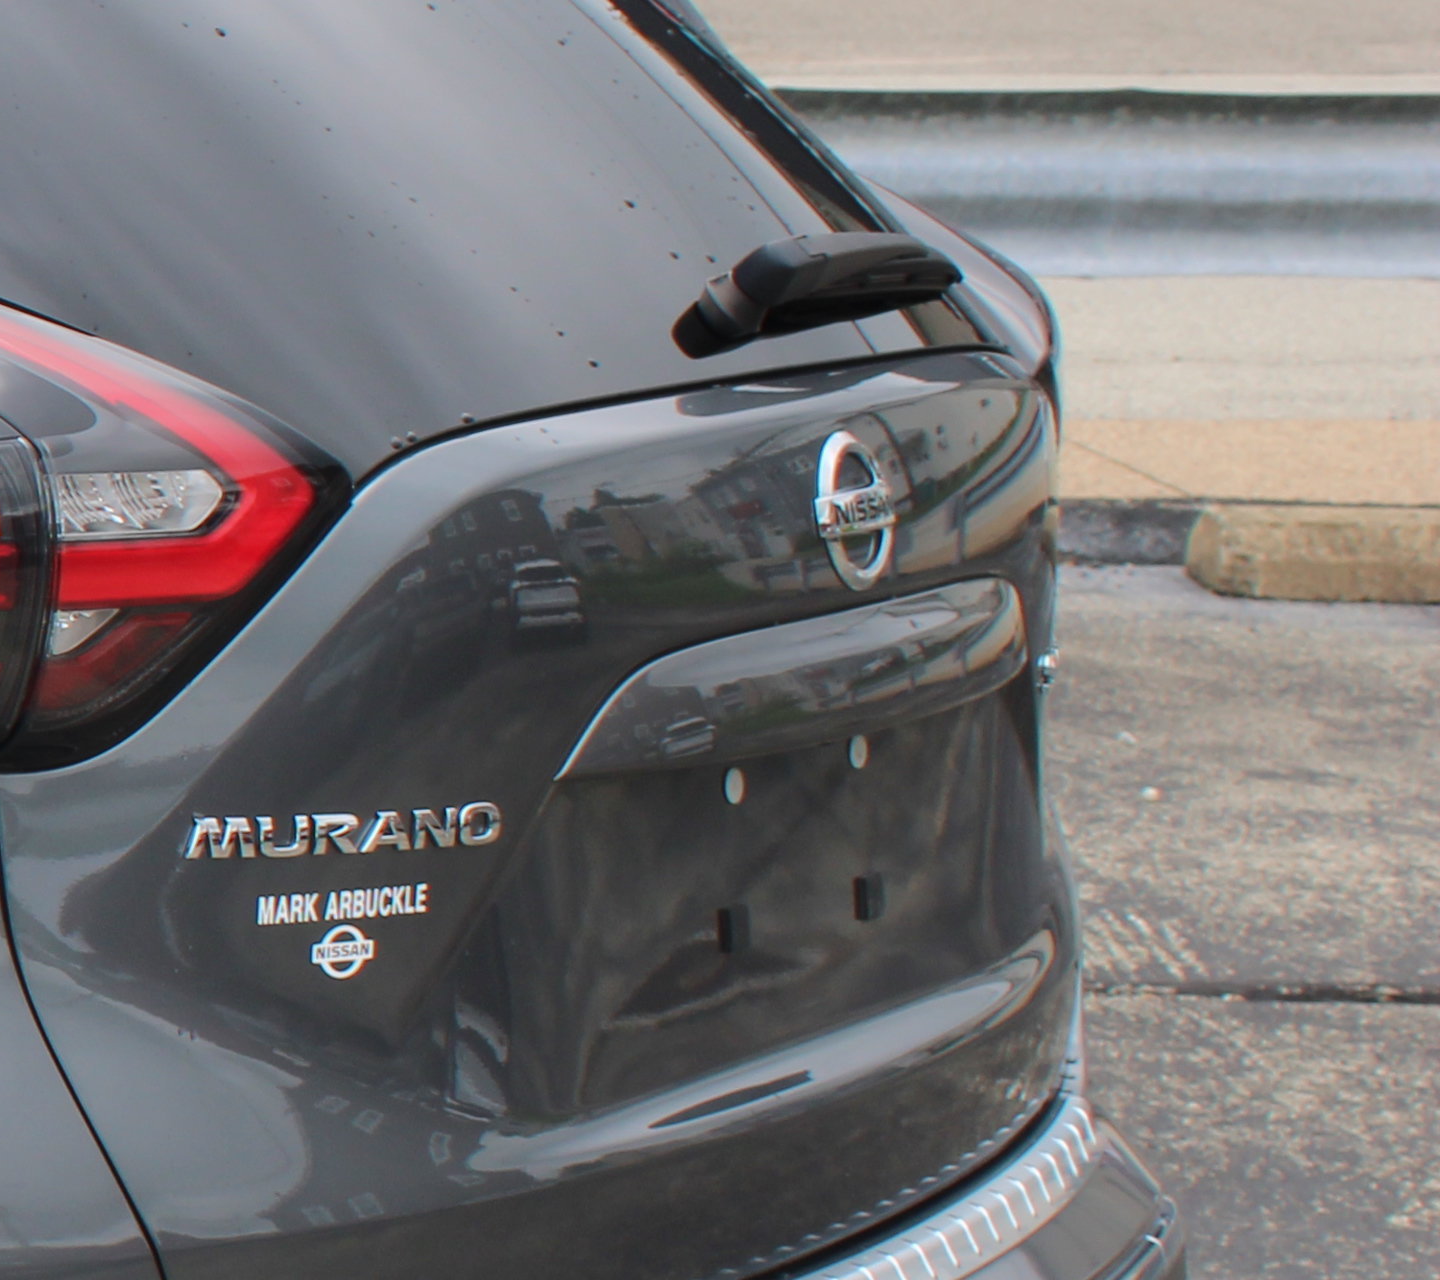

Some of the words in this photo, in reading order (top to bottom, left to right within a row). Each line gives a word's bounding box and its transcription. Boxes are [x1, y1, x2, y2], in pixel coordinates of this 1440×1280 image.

[184, 801, 503, 860] MURANO
[257, 893, 320, 926] MARK
[324, 883, 430, 921] ARBUCKLE
[316, 943, 370, 960] NISSAN
